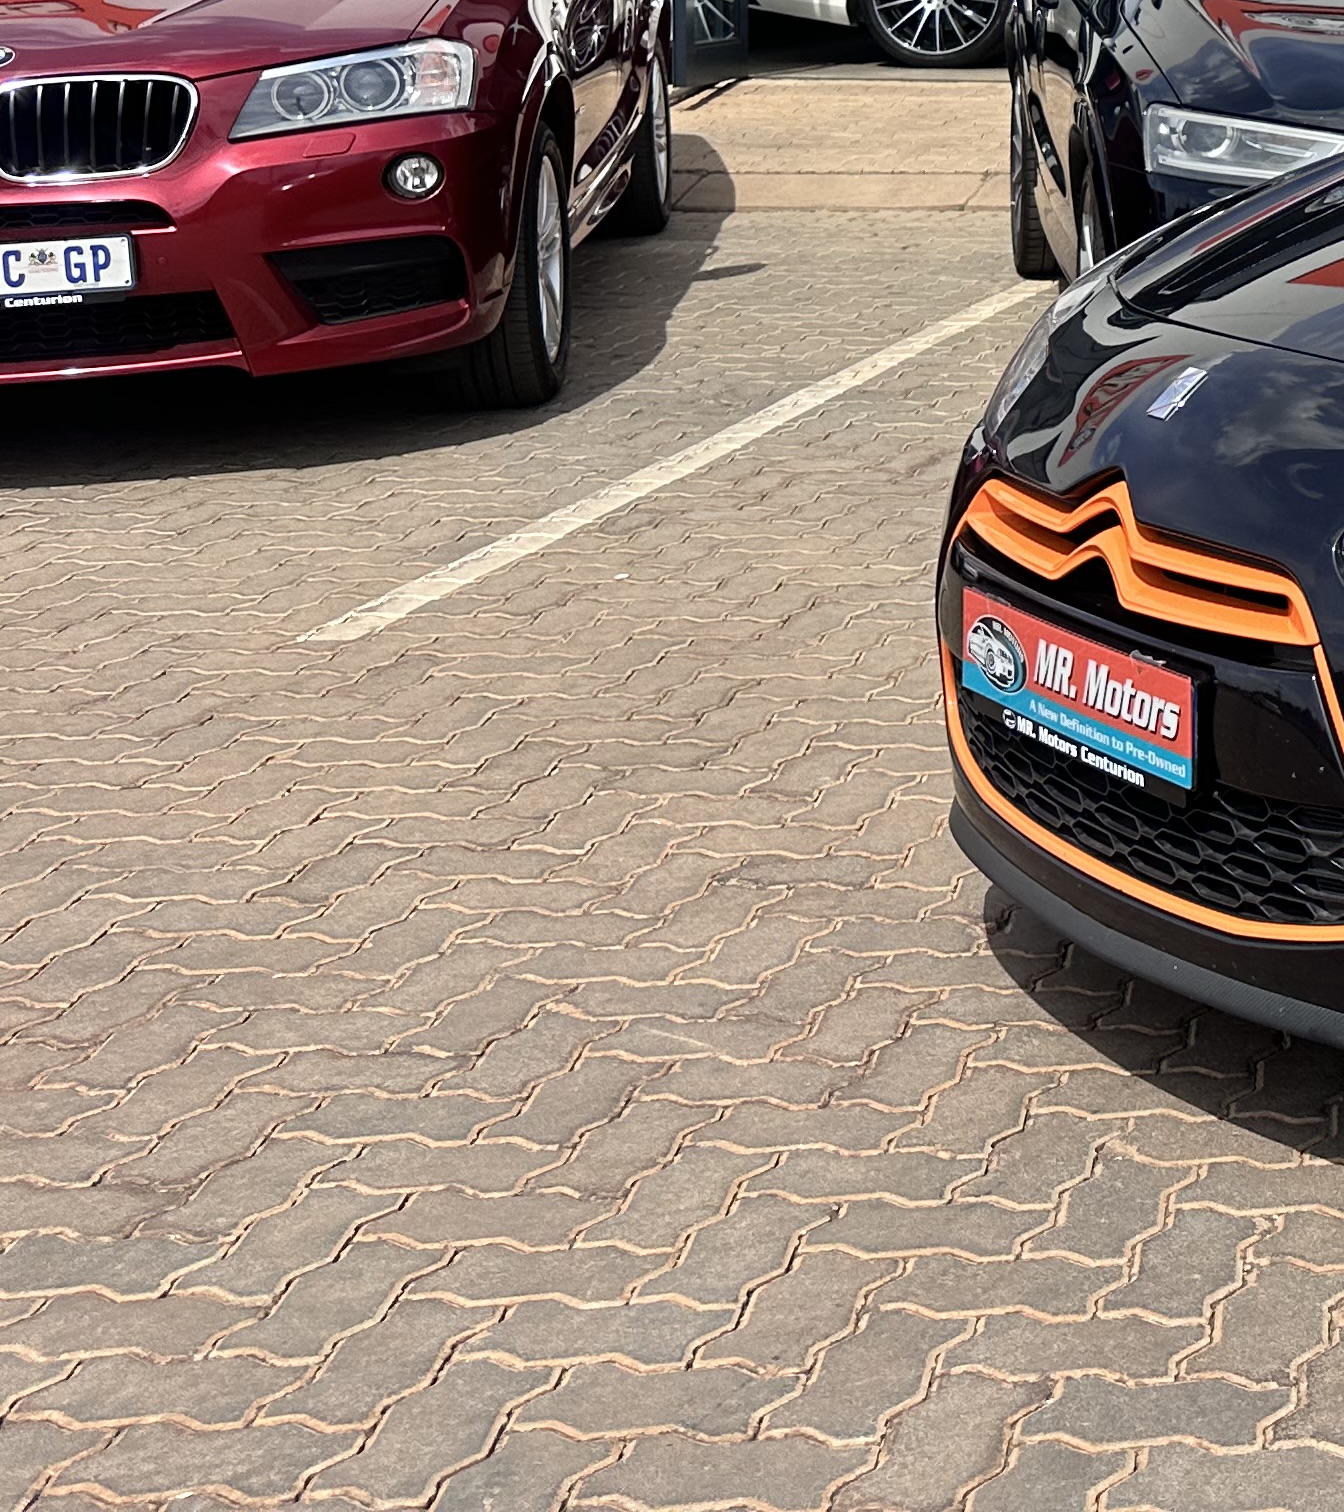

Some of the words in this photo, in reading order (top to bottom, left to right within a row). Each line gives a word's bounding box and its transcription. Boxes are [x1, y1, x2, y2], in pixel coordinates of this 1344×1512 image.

[64, 244, 111, 284] GP
[4, 294, 83, 308] Centurion
[1033, 639, 1077, 700] MR.
[1082, 659, 1181, 741] Motors
[1016, 716, 1036, 739] MR.
[1038, 725, 1078, 758] Motors
[1080, 746, 1146, 788] Centurion
[1029, 699, 1038, 713] A
[1038, 703, 1058, 722] New
[1059, 712, 1110, 746] Definition
[1112, 735, 1124, 752] to
[1125, 743, 1186, 779] Pre-Owned
